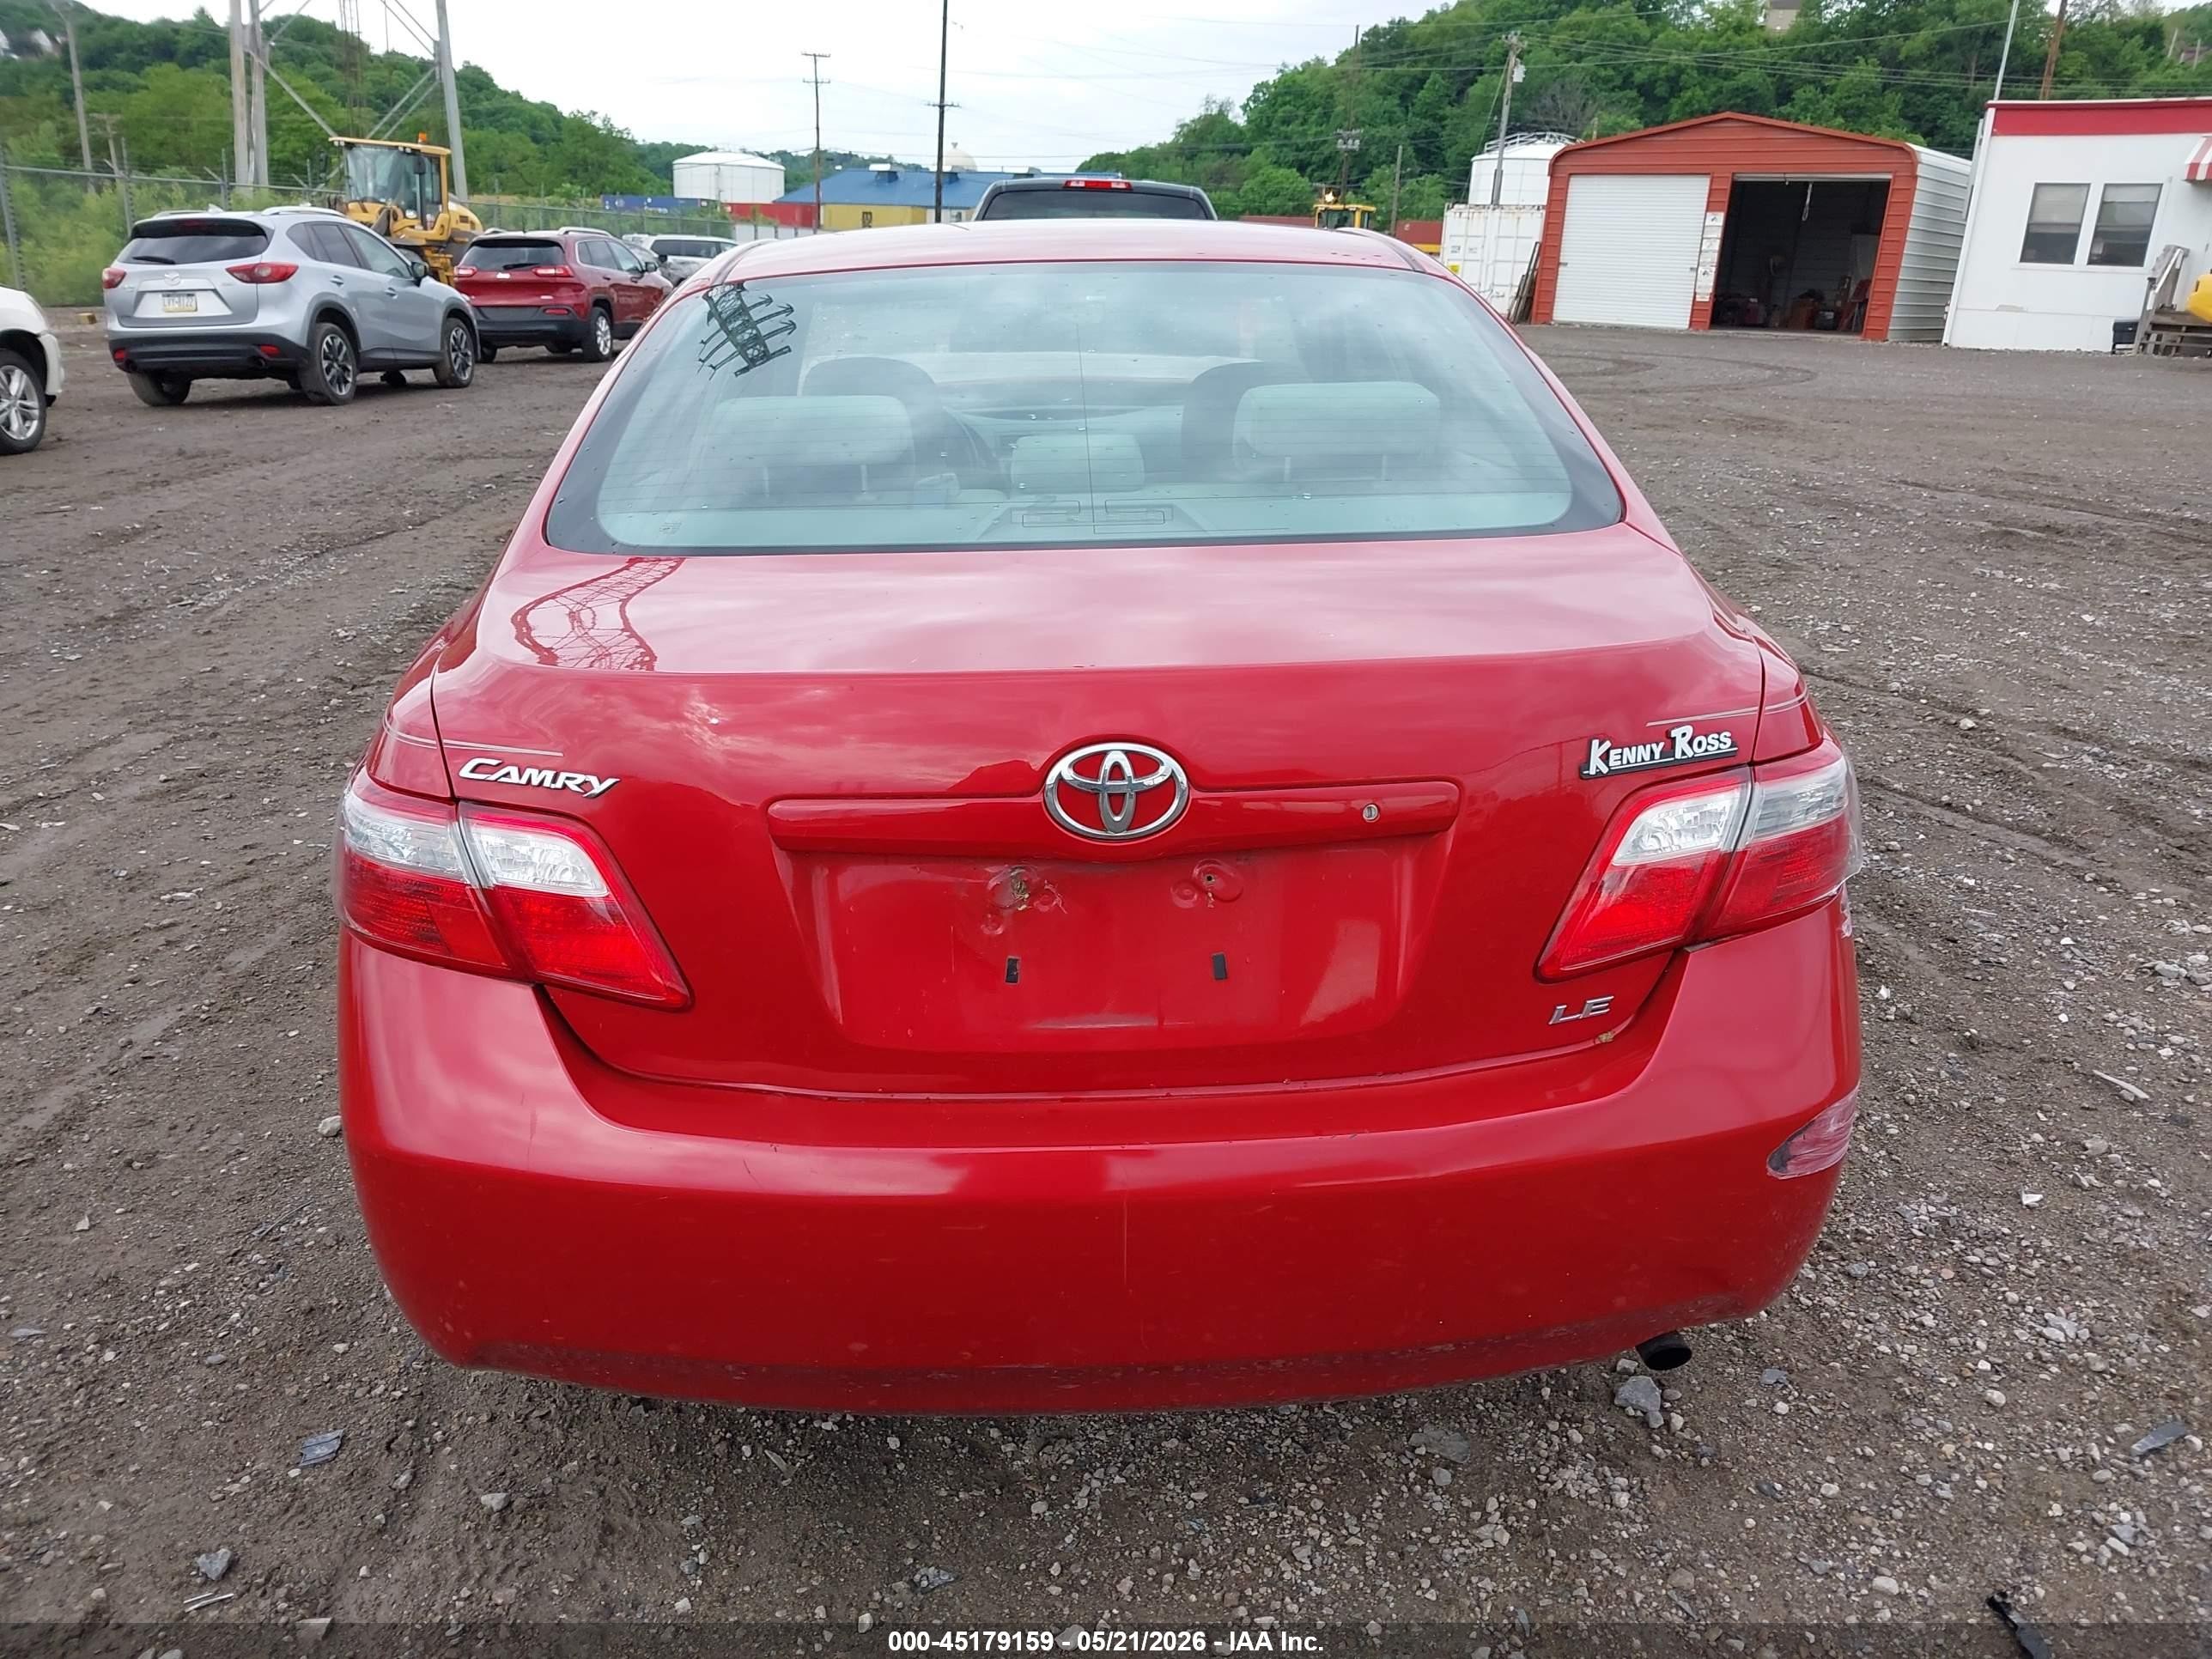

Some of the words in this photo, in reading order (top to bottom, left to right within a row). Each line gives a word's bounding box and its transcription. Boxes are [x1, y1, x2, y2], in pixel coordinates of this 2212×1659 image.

[1589, 739, 1665, 775] KENNY
[1670, 725, 1732, 758] ROSS
[459, 757, 621, 798] CAMRY
[1548, 995, 1614, 1025] LE
